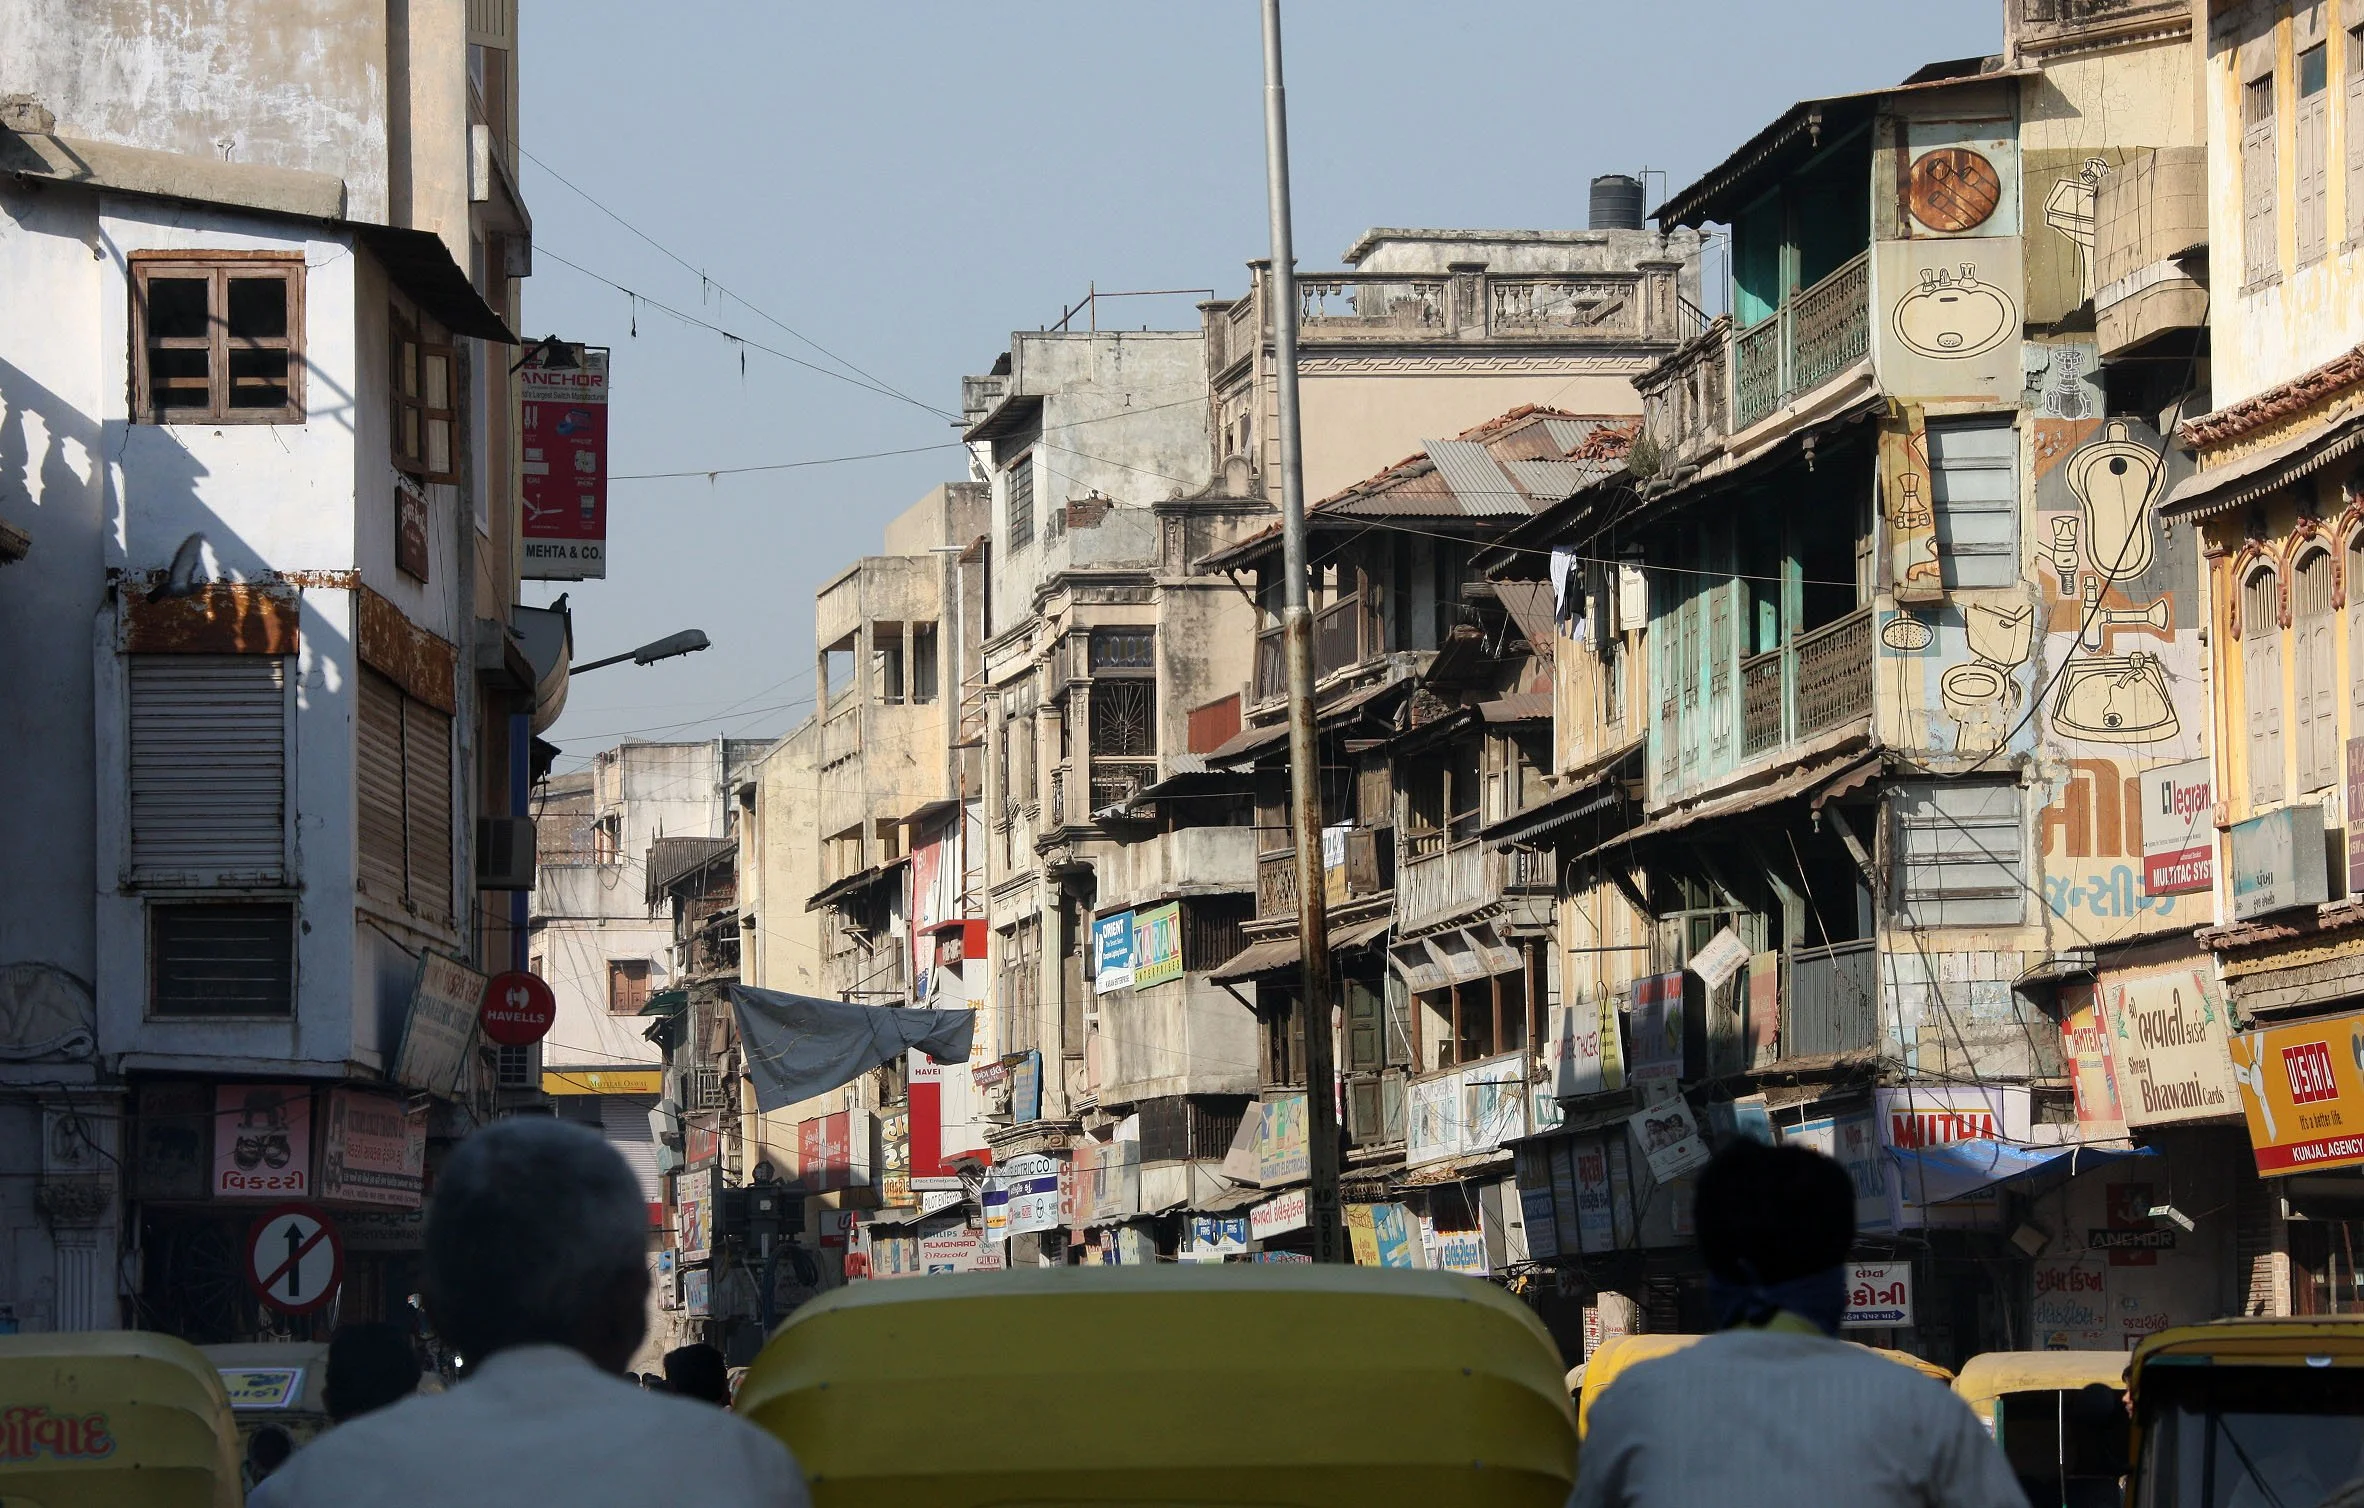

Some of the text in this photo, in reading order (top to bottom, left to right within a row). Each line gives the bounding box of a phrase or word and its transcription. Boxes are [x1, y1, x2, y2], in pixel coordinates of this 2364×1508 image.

[521, 372, 603, 387] ANCHOR
[526, 544, 602, 560] MEHTA & CO.
[2153, 863, 2191, 887] MULTITAC
[1102, 919, 1124, 938] ORIENT
[1135, 918, 1178, 966] KARAN
[1135, 959, 1180, 983] ENTERPRISES
[487, 1010, 545, 1024] HAVELLS
[2128, 996, 2138, 1019] શ્રી
[2138, 987, 2186, 1051] ભવાની
[2073, 1027, 2100, 1054] AMTEX
[2286, 1051, 2335, 1096] USHA
[2128, 1056, 2225, 1113] Shree Bhawani Cards
[2299, 1114, 2310, 1130] It's
[2315, 1112, 2331, 1128] better
[2331, 1109, 2343, 1126] life.
[1892, 1113, 1995, 1148] MUTHA
[2292, 1138, 2364, 1162] KUNJAL AGENCY
[1036, 1159, 1052, 1173] CO.
[222, 1170, 304, 1190] વિકટરી
[923, 1230, 957, 1238] PHILIPS
[923, 1240, 977, 1248] ALMONARD
[2092, 1232, 2173, 1247] ANCHOR
[933, 1251, 968, 1259] Racold
